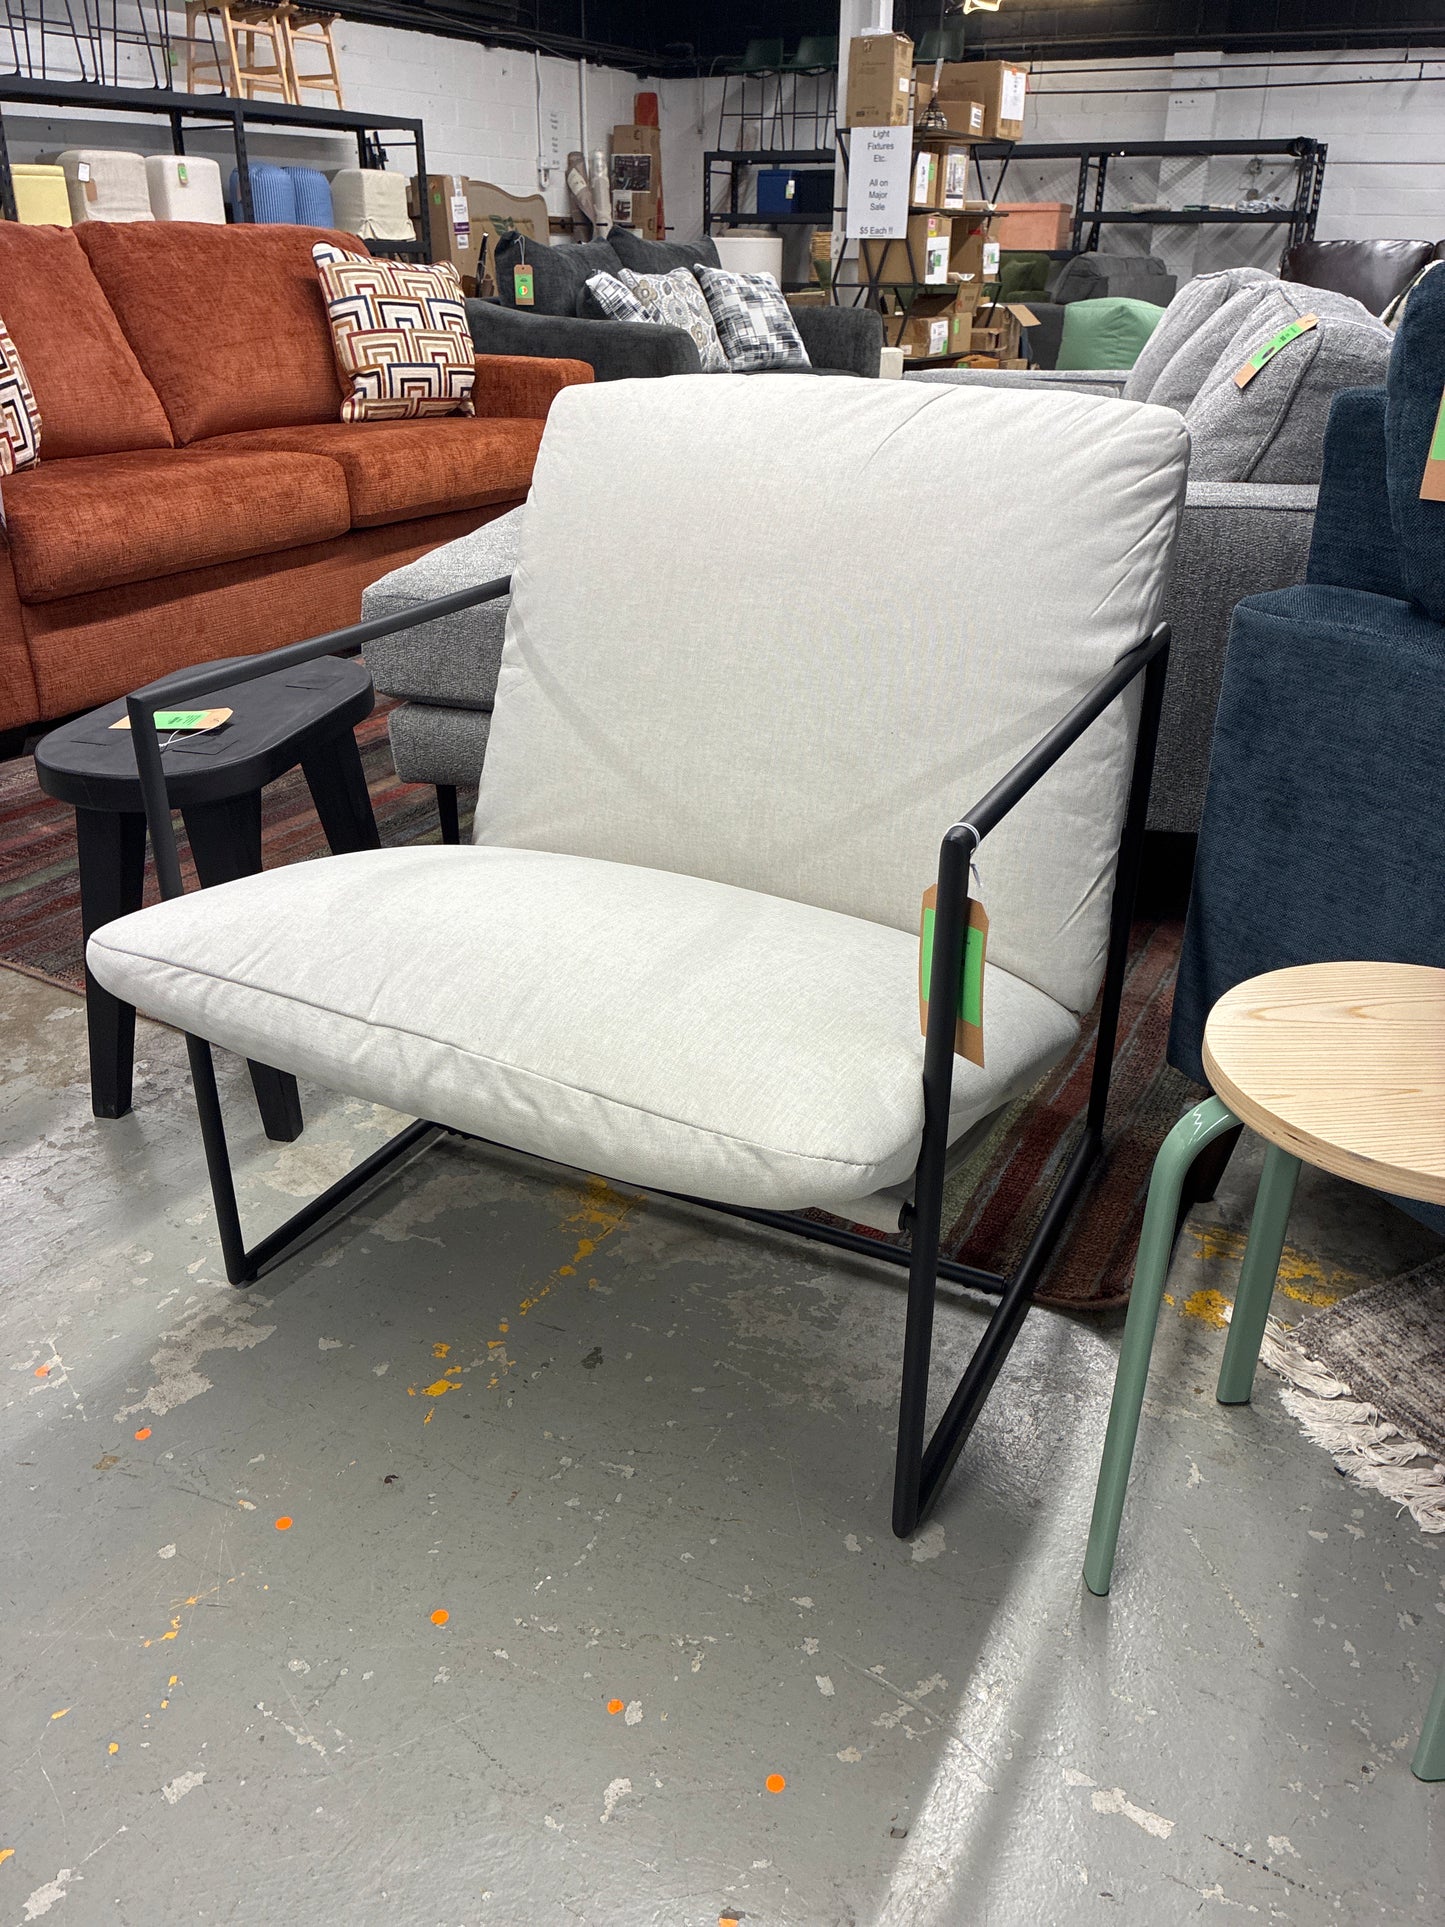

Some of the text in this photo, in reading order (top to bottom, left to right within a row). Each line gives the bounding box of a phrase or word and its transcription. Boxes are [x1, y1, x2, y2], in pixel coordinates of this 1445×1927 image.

[873, 130, 890, 139] Light
[867, 142, 895, 150] Fixtures
[869, 179, 878, 187] All
[869, 191, 888, 200] Major
[870, 203, 886, 211] Sale
[859, 227, 868, 235] $5
[870, 227, 887, 235] Each
